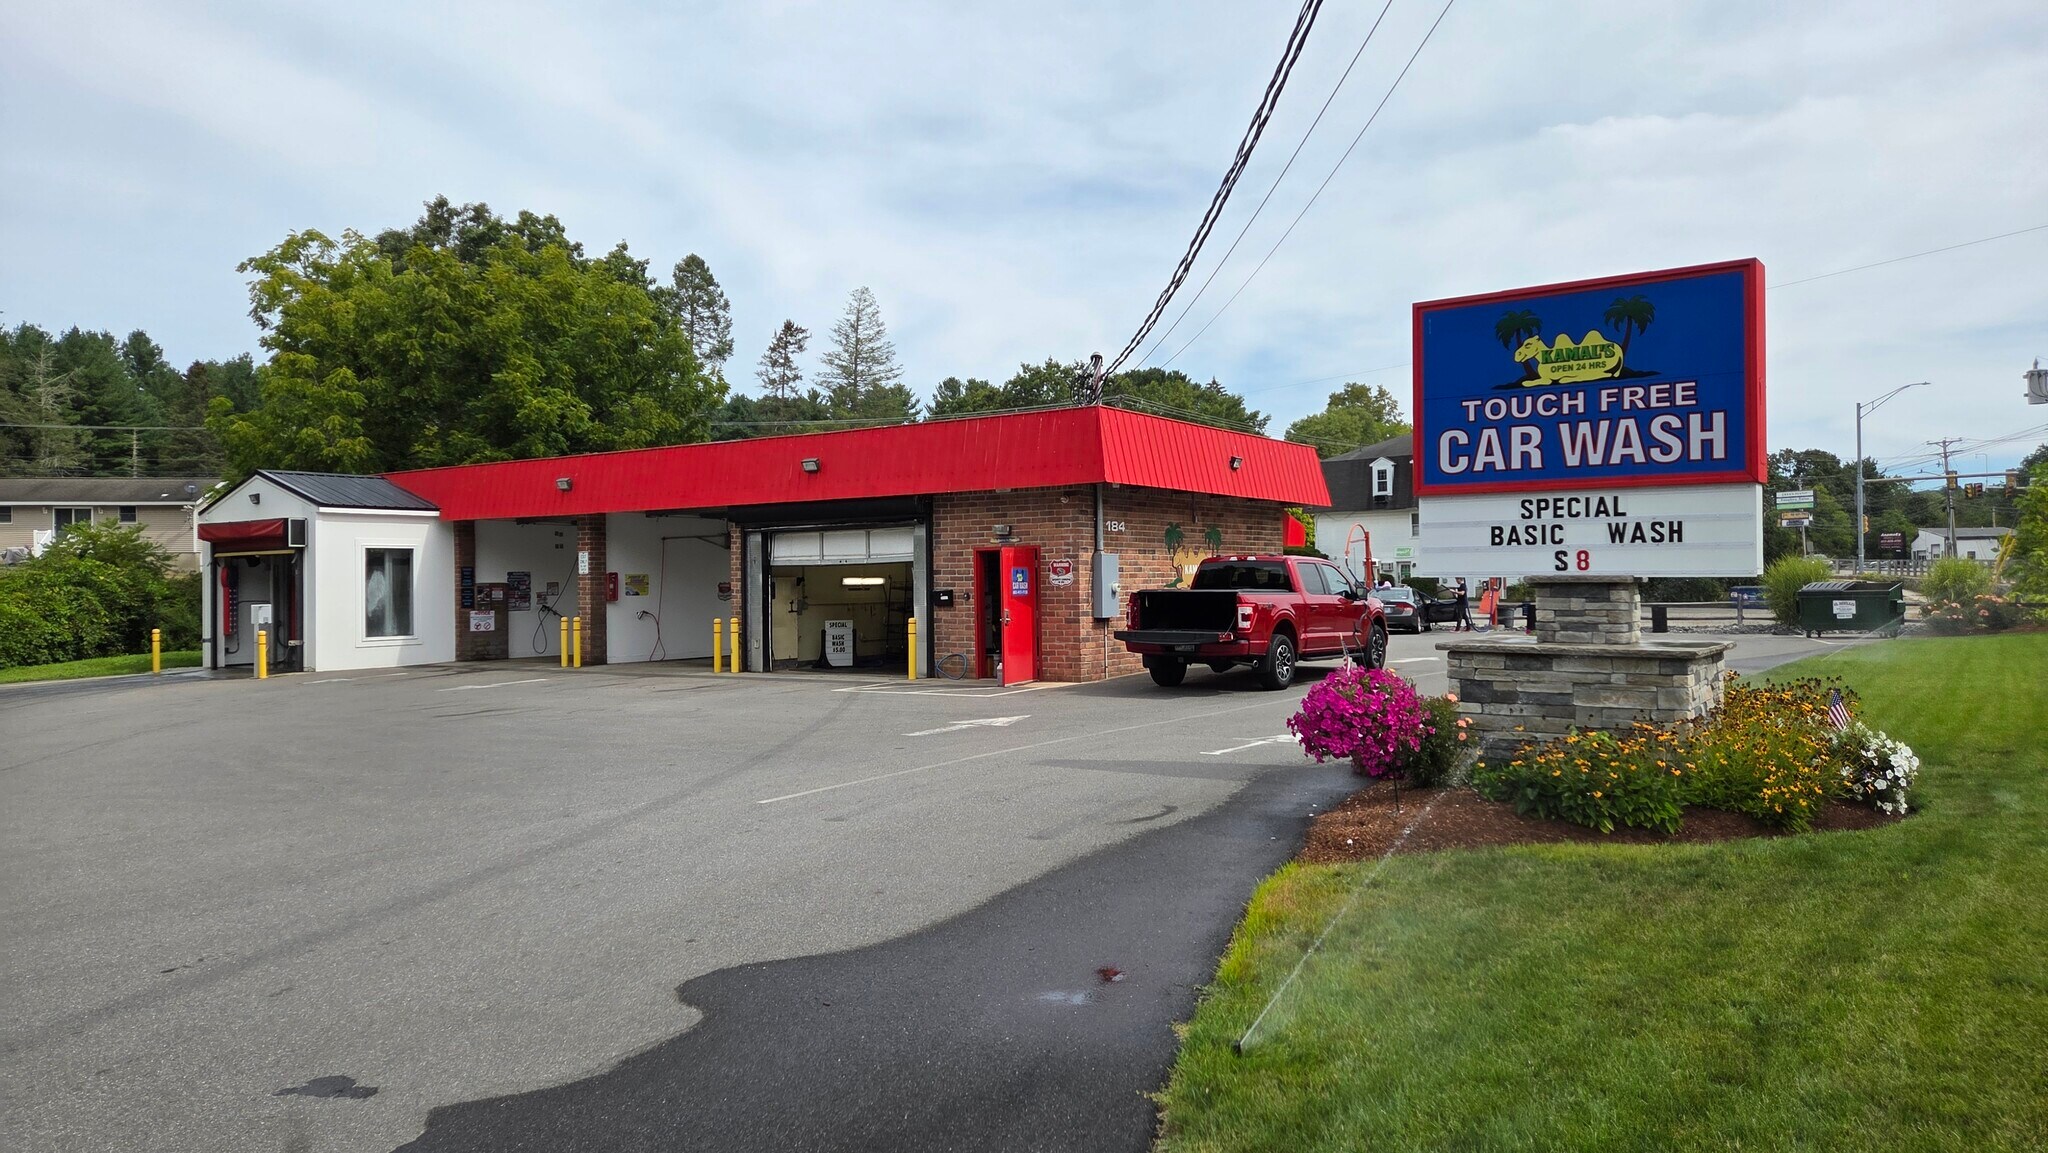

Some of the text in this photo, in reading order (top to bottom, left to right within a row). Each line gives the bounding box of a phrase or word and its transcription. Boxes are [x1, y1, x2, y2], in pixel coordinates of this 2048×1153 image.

[1541, 343, 1616, 364] KAMAL'S
[1550, 361, 1607, 373] OPEN 24 HRS
[1461, 381, 1698, 422] TOUCH FREE
[1439, 410, 1727, 474] CAR WASH
[1520, 496, 1627, 519] SPECIAL
[1105, 520, 1126, 532] 184
[1490, 521, 1683, 546] BASIC WASH
[1184, 564, 1199, 575] KAM
